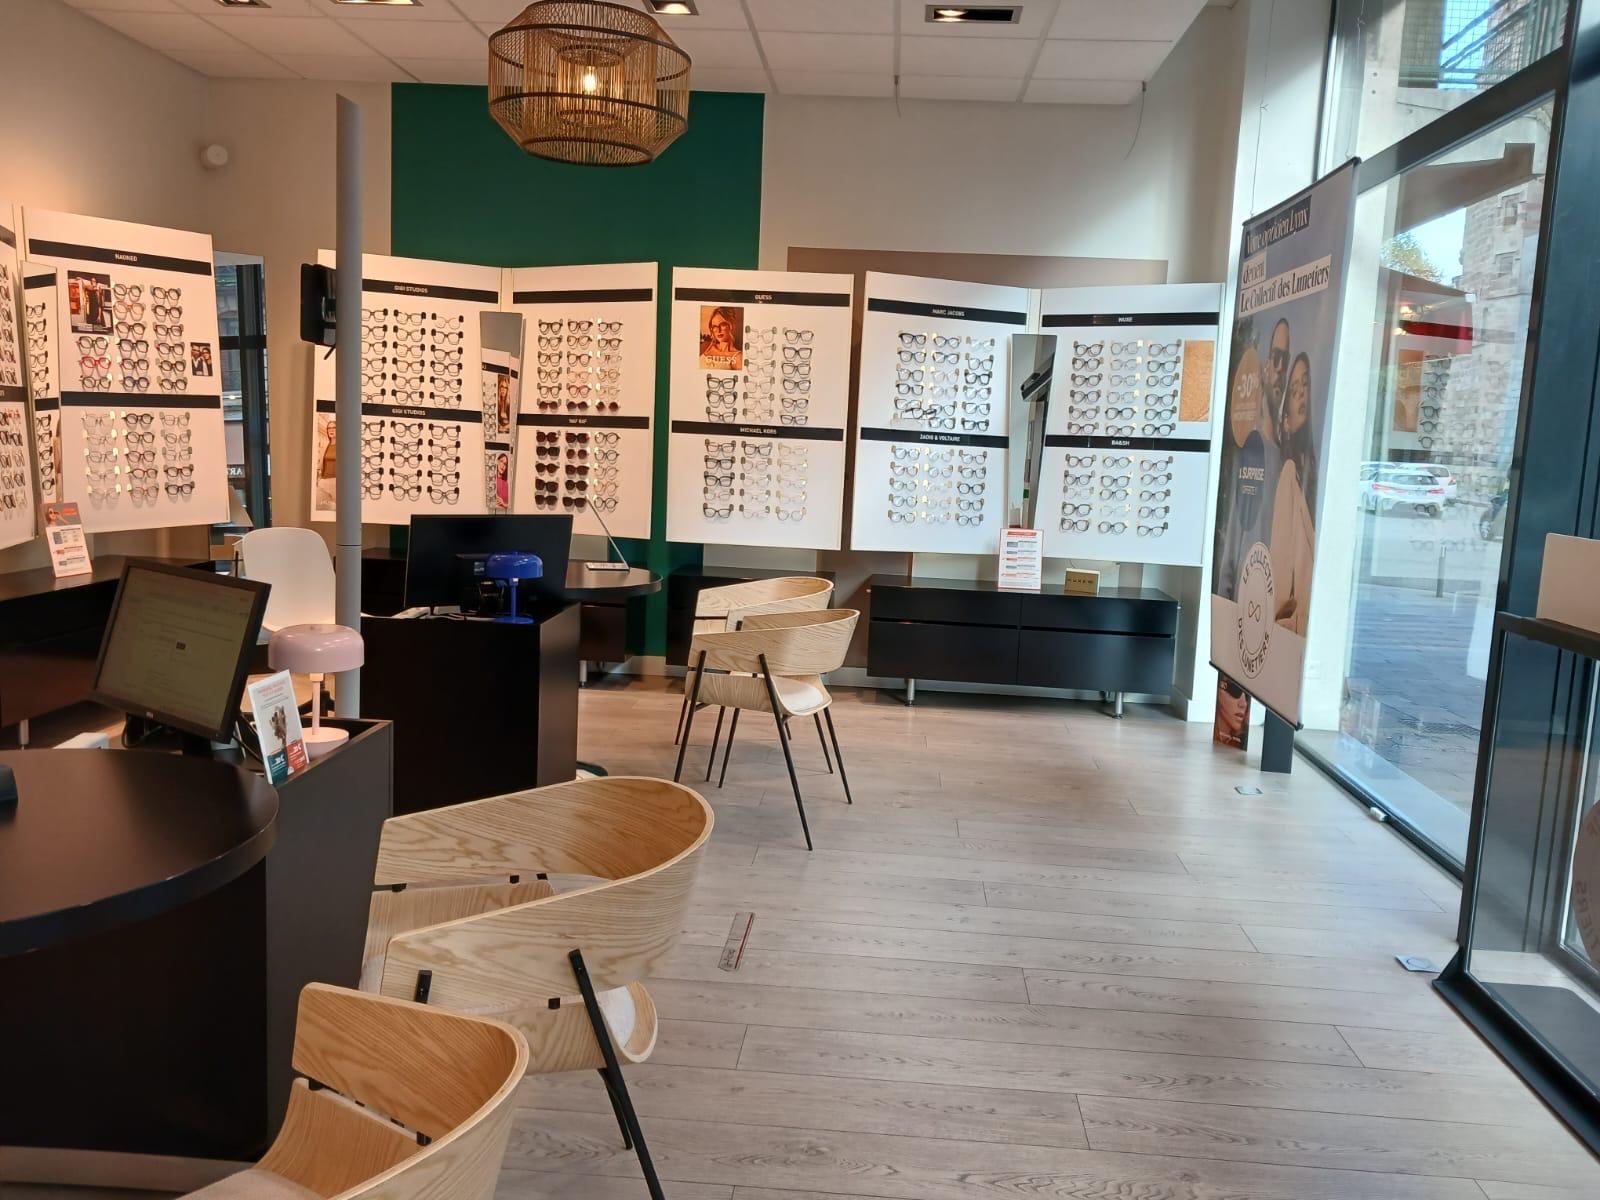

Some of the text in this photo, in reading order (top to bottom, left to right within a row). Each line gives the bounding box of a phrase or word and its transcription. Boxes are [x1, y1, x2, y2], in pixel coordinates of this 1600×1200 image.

[1240, 265, 1330, 313] Le Collectif des Lunetiers
[705, 355, 737, 365] GUESS
[1241, 466, 1265, 481] SURPRISE
[1250, 550, 1274, 597] COLLECTIF
[1241, 631, 1270, 673] LUNETIERS
